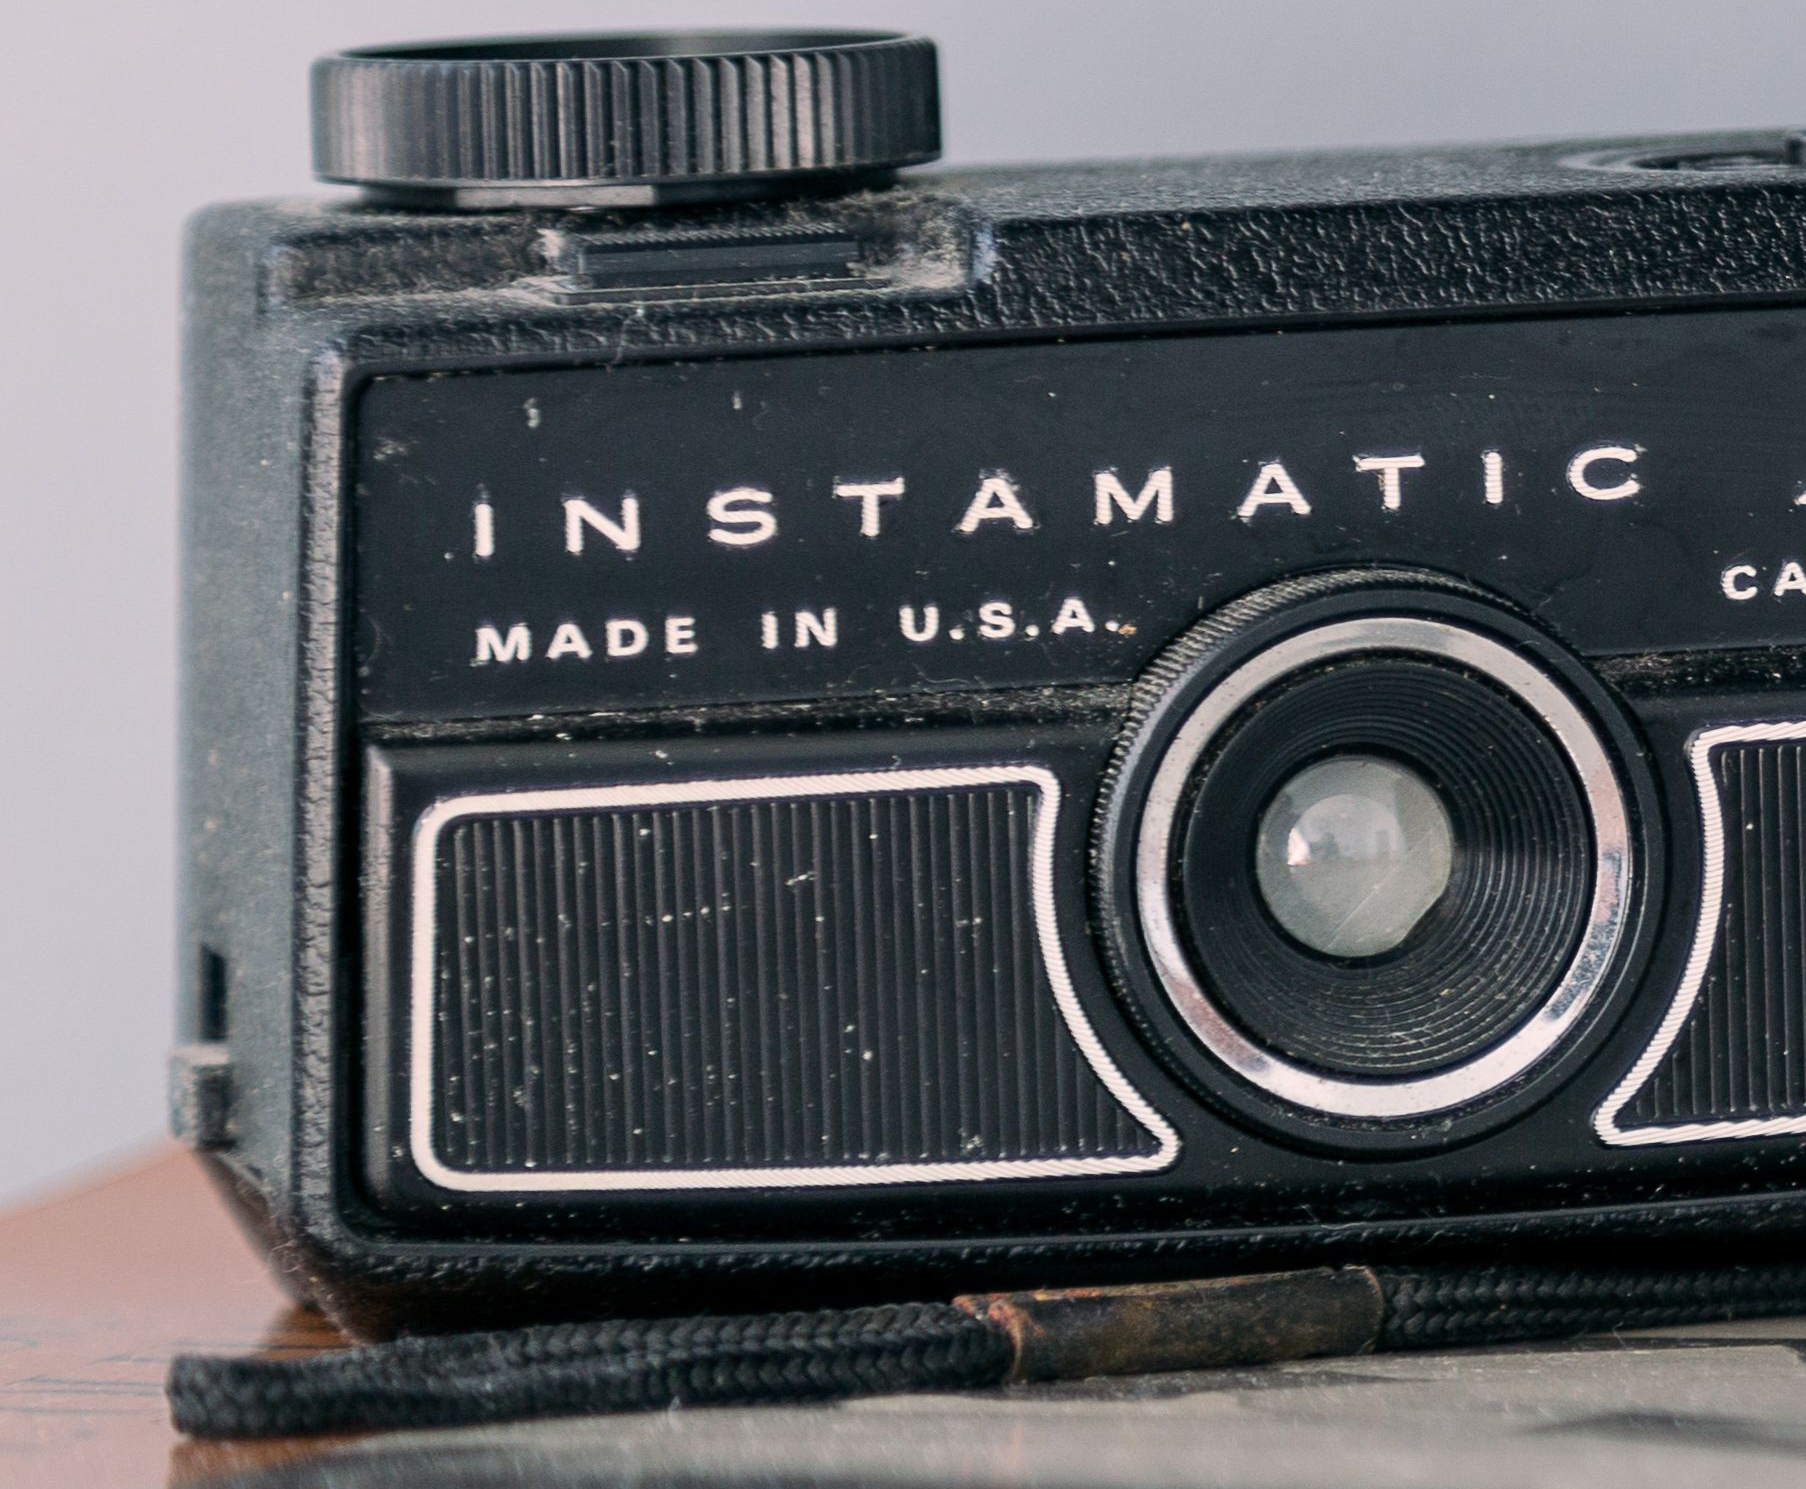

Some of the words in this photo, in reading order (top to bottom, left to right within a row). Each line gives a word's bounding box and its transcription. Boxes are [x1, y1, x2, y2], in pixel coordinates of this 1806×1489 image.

[472, 446, 1642, 559] INSTAMATIC
[474, 617, 700, 664] MADE
[760, 607, 839, 650] IN
[899, 596, 1121, 643] U.S.A.
